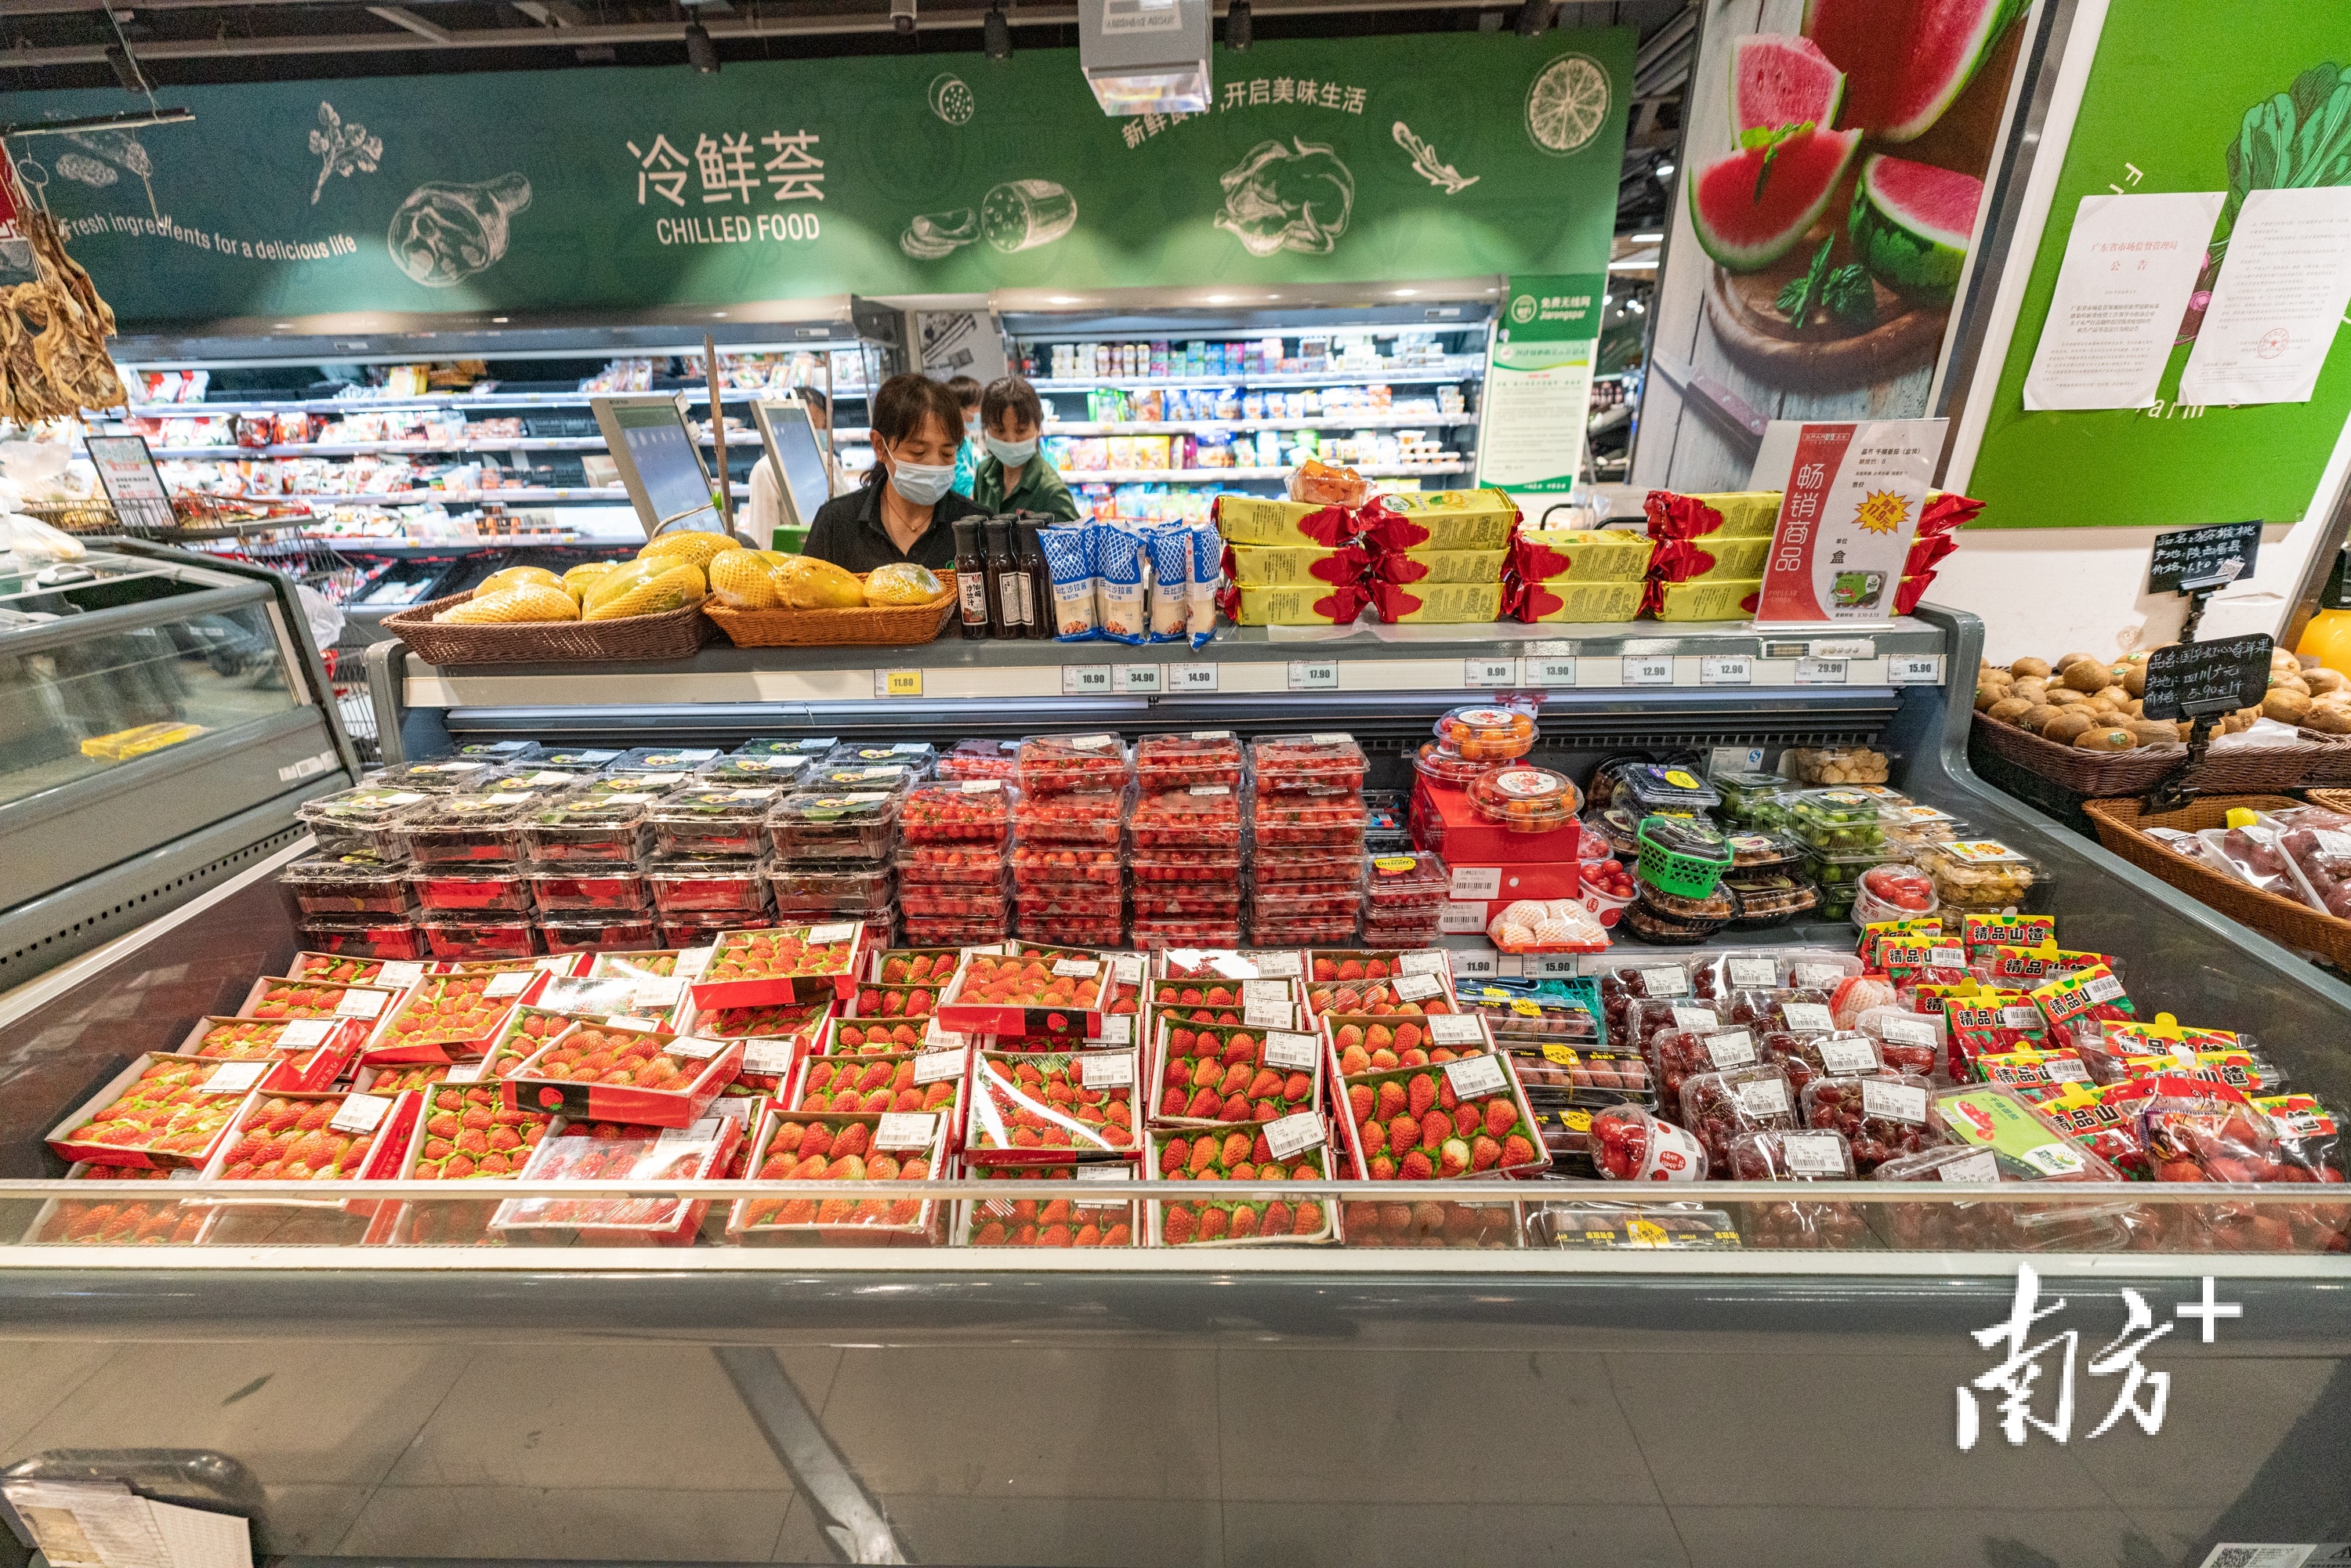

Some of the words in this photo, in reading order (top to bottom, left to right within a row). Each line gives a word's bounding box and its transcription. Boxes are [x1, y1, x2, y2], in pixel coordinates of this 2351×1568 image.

[626, 129, 824, 207] 冷鲜荟
[657, 215, 752, 244] CHILLED
[757, 212, 820, 241] FOOD
[214, 232, 237, 255] for
[241, 242, 253, 258] a
[255, 240, 330, 260] delicious
[329, 234, 357, 255] life
[2135, 398, 2206, 419] arm
[1774, 462, 1826, 572] 畅销商品
[1867, 503, 1891, 527] 17.9元
[1830, 550, 1846, 564] 盒
[1310, 669, 1331, 679] 17.90
[1487, 667, 1506, 676] 9.90
[1546, 666, 1569, 675] 13.90
[1643, 667, 1665, 676] 12.90
[1721, 664, 1744, 674] 12.90
[1817, 664, 1842, 673] 29.90
[1909, 664, 1932, 673] 15.90
[893, 678, 914, 687] 11.80
[1082, 674, 1105, 683] 10.90
[1131, 673, 1154, 683] 34.90
[1188, 672, 1210, 682] 14.90
[1973, 925, 2045, 942] 精品山楂
[1889, 948, 1933, 964] 精品山
[1466, 961, 1490, 972] 11.90
[1545, 961, 1570, 972] 15.90
[2049, 987, 2092, 1016] 精品山
[1958, 1009, 2006, 1027] 精品山
[1994, 1065, 2053, 1085] 精品山
[2052, 1103, 2121, 1133] 精品山
